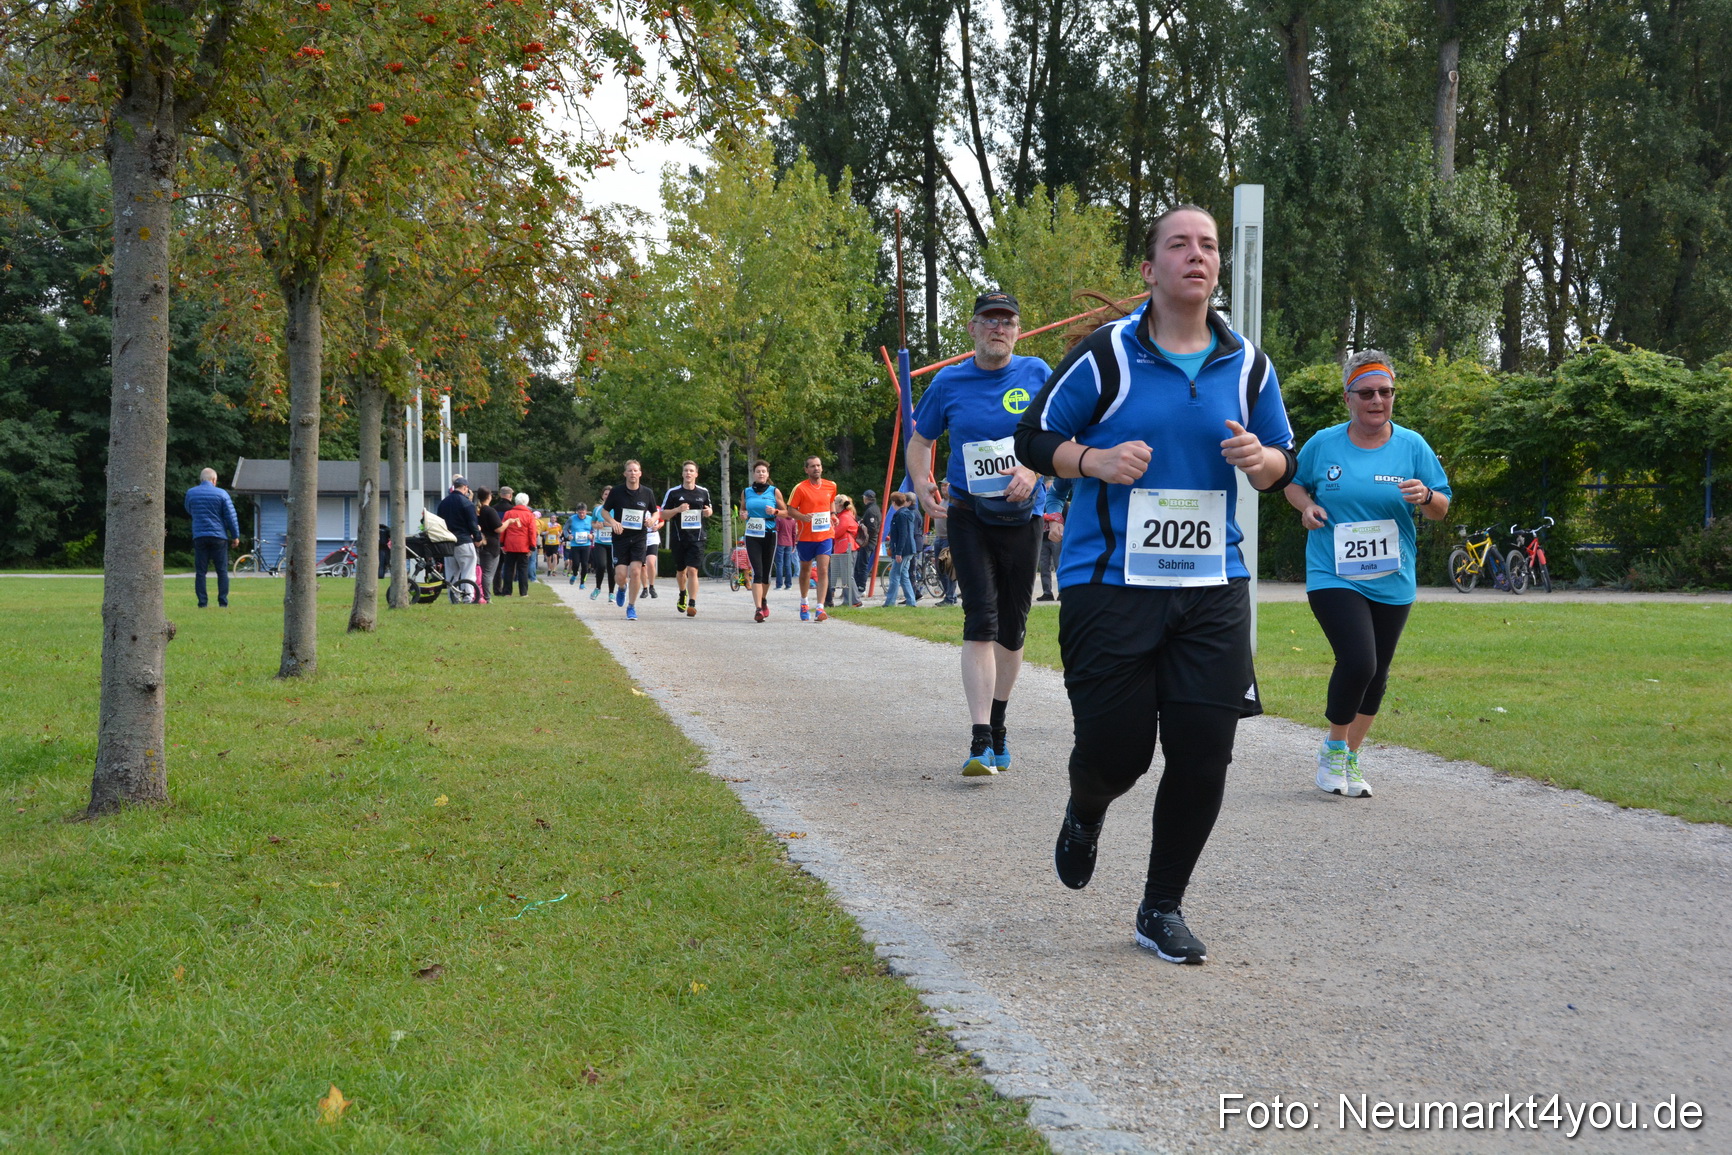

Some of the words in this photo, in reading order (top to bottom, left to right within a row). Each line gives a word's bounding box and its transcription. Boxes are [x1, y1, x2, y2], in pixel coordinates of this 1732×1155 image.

[974, 454, 1016, 476] 3000
[1374, 475, 1405, 483] BOCK
[1169, 499, 1199, 507] BOCK
[624, 514, 640, 522] 2262
[814, 517, 829, 525] 2574
[747, 523, 763, 531] 2649
[1142, 519, 1212, 549] 2026
[1344, 537, 1388, 559] 2511
[1158, 558, 1195, 570] Sabrina
[1360, 563, 1378, 571] Anita
